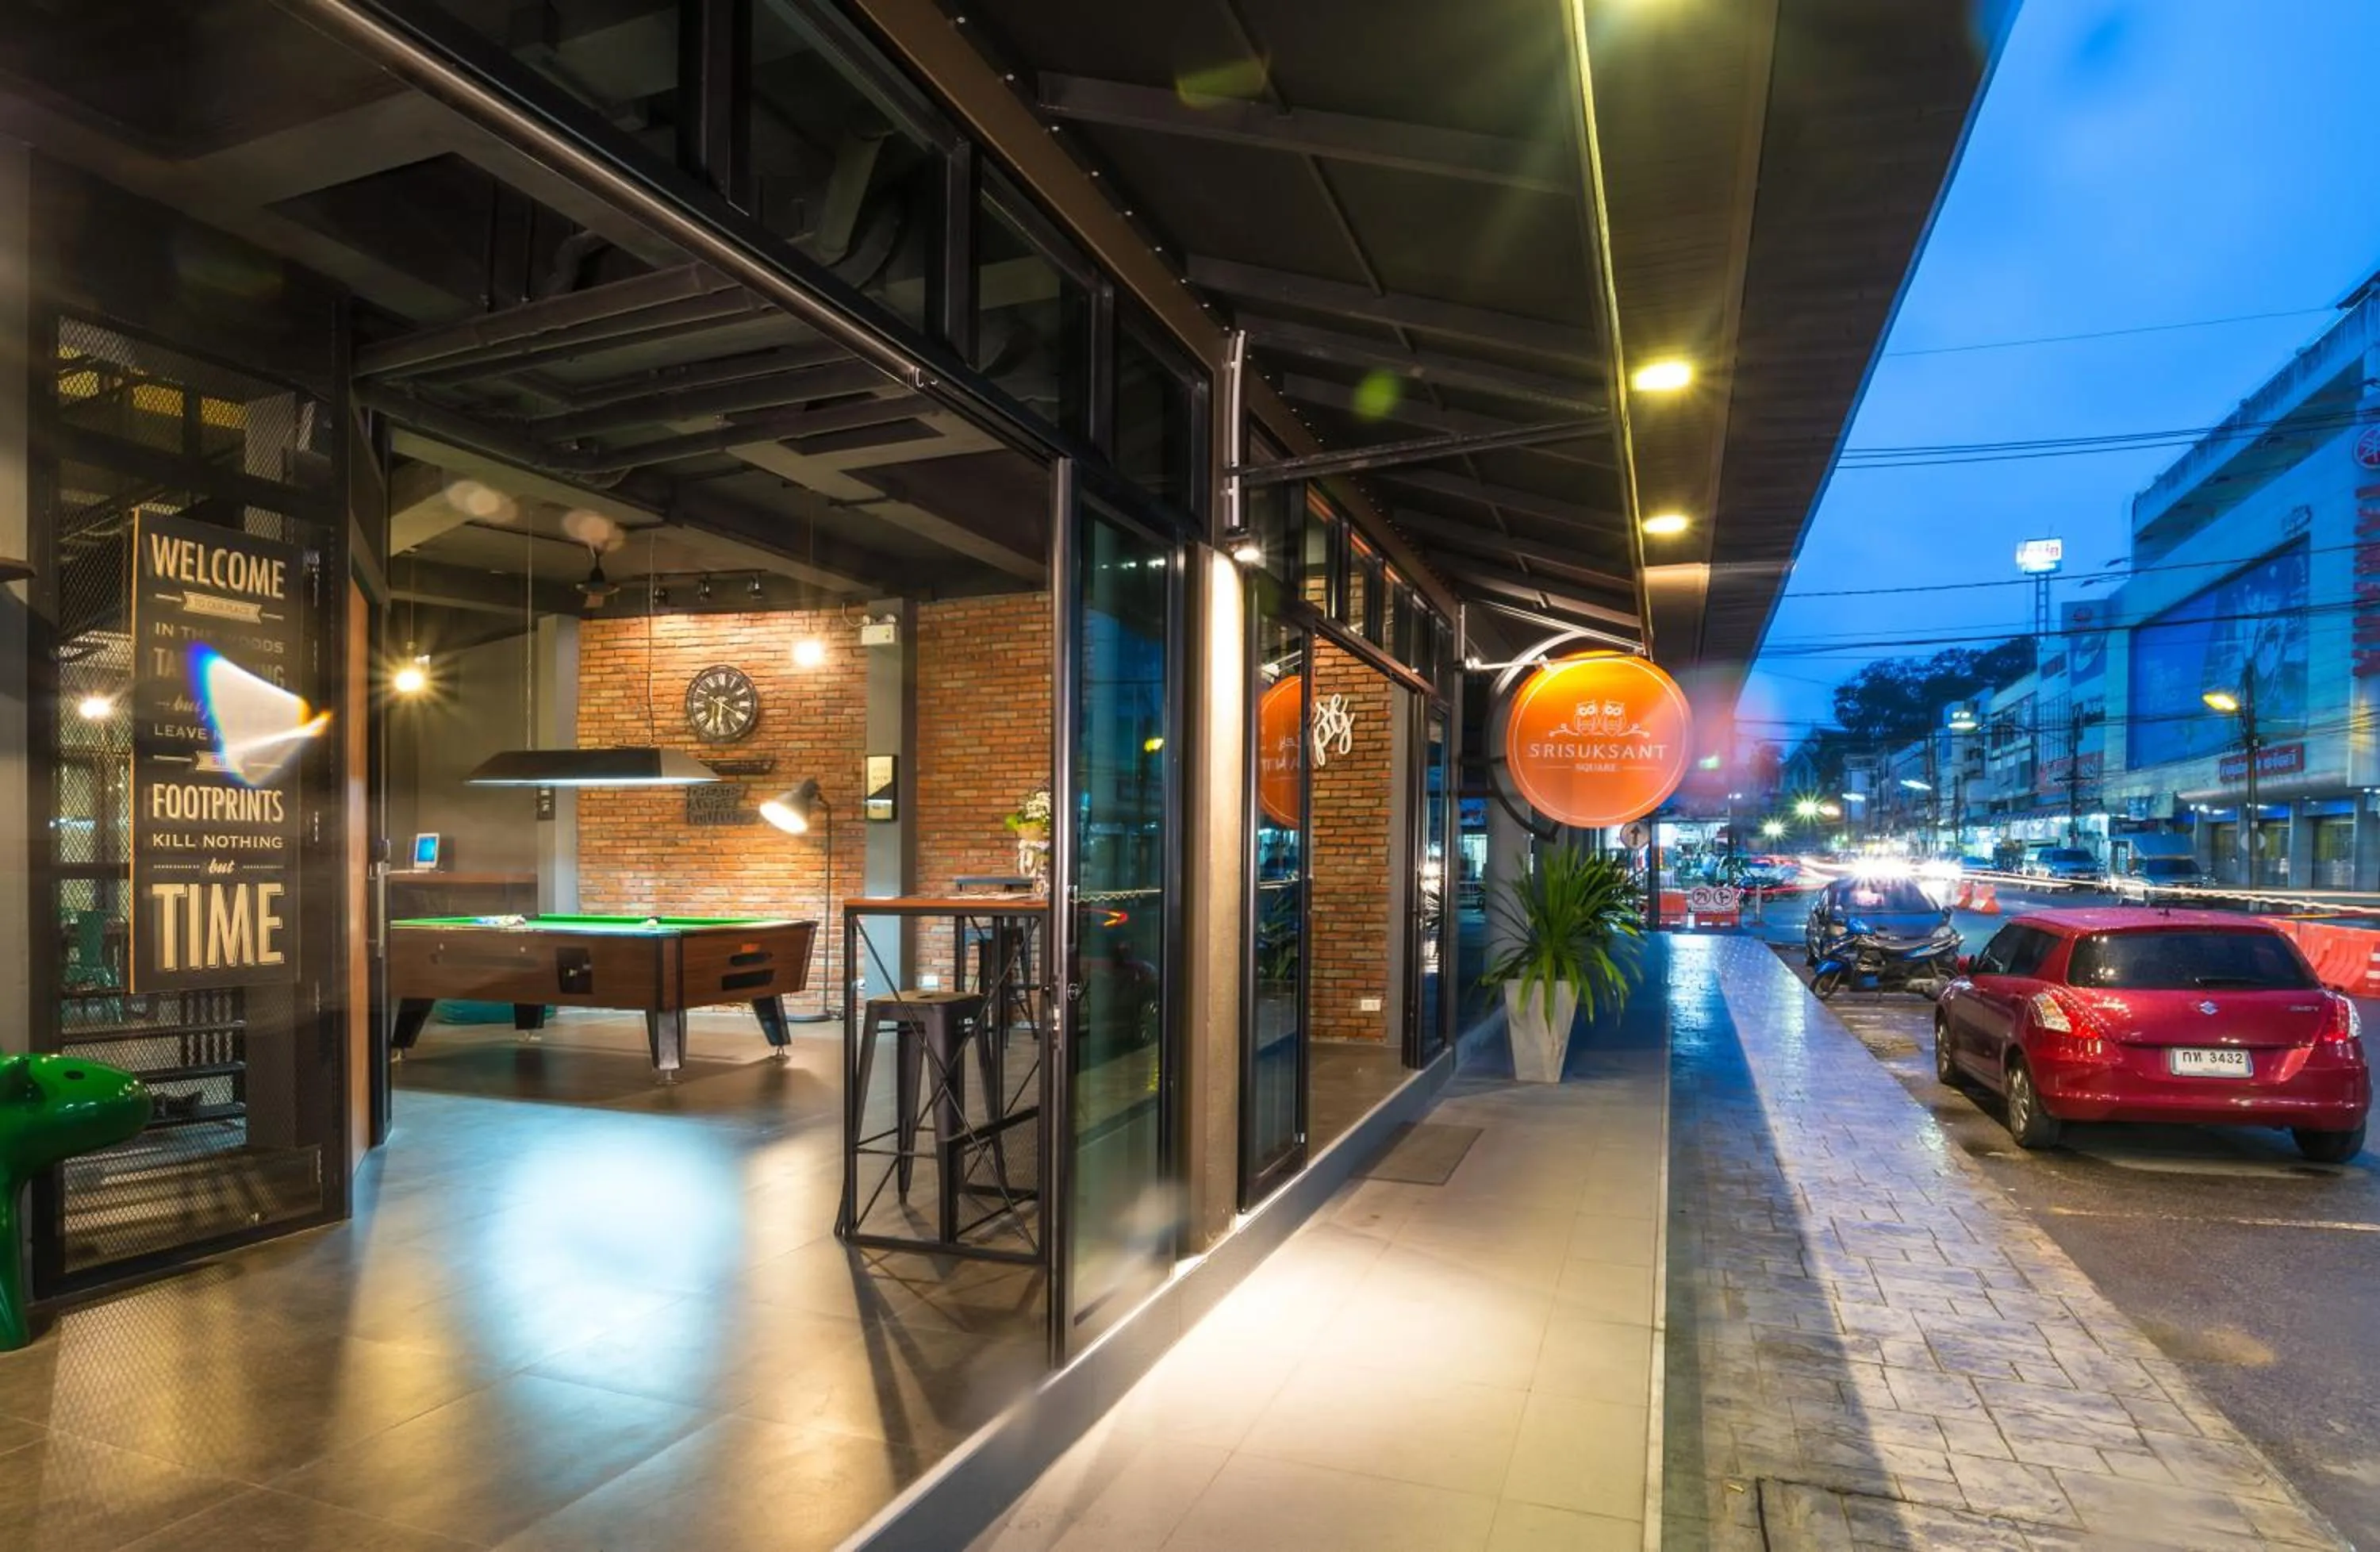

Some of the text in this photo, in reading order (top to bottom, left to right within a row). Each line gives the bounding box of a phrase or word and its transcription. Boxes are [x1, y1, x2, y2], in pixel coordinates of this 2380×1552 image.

[151, 532, 286, 599] WELCOME
[155, 621, 174, 637] IN
[154, 723, 208, 740] LEAVE
[1530, 743, 1668, 761] SRISUKSANT
[1575, 763, 1618, 773] SQUARE
[153, 782, 284, 824] FOOTPRINTS
[153, 833, 283, 849] KILL NOTHING
[208, 857, 235, 874] but
[152, 882, 285, 972] TIME
[2209, 1051, 2243, 1064] 3432
